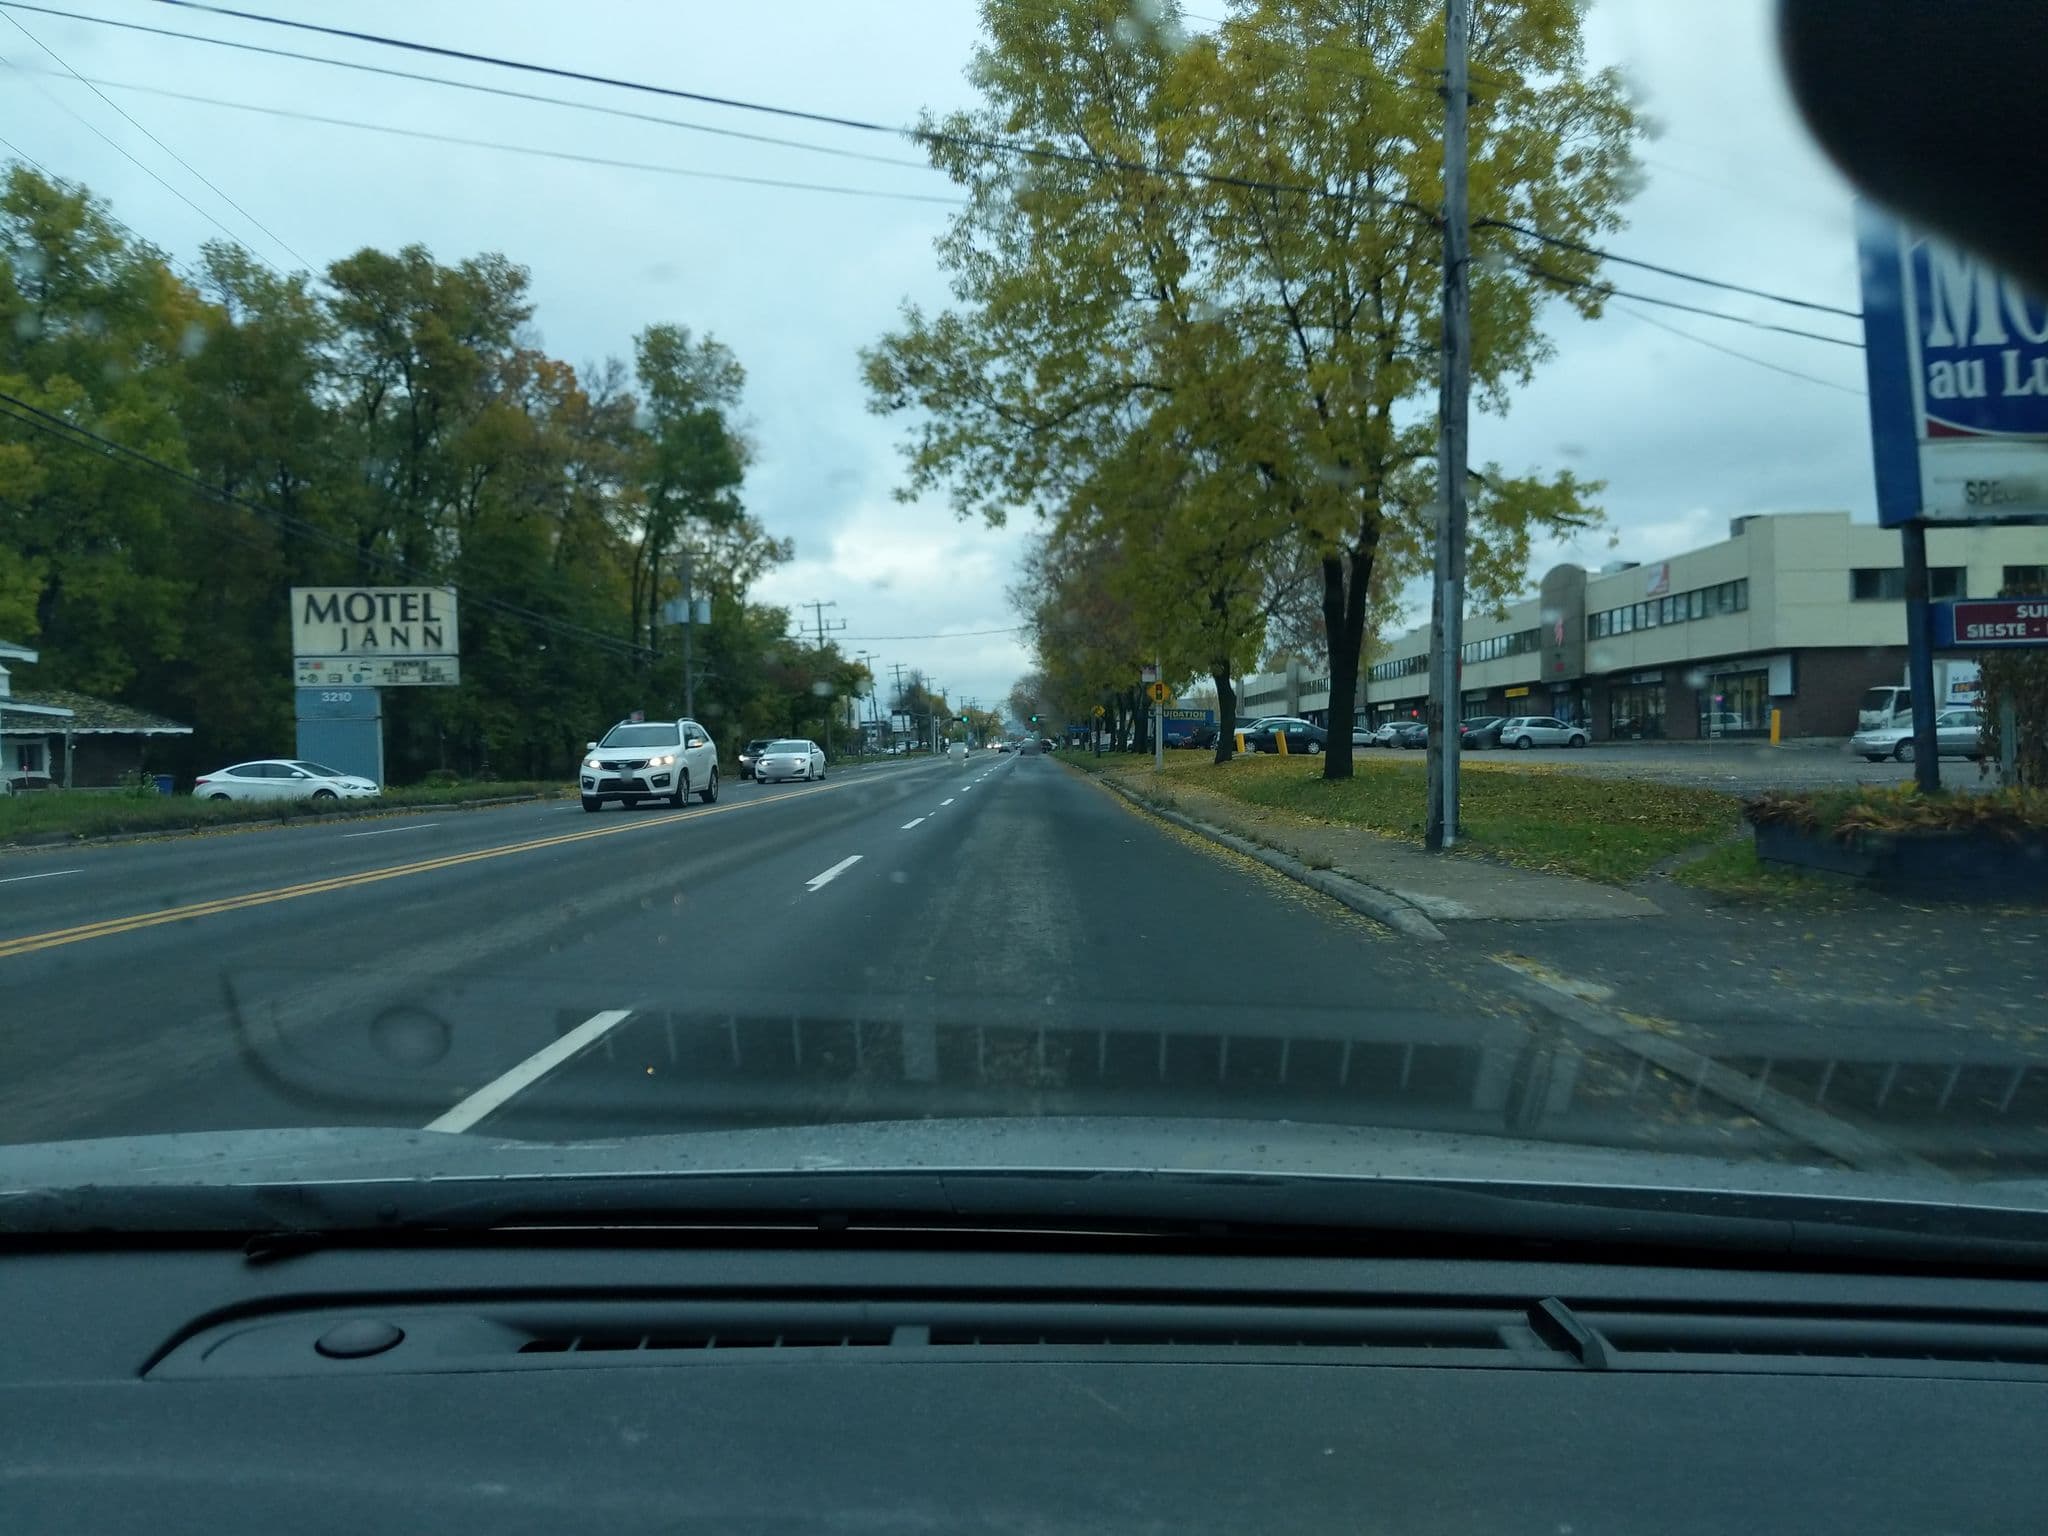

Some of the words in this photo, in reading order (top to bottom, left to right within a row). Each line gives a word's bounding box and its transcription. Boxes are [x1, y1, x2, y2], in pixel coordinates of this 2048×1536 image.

[1927, 358, 1987, 399] au
[304, 592, 441, 625] MOTEL
[340, 626, 443, 652] JANN
[1967, 623, 2027, 638] SIESTE
